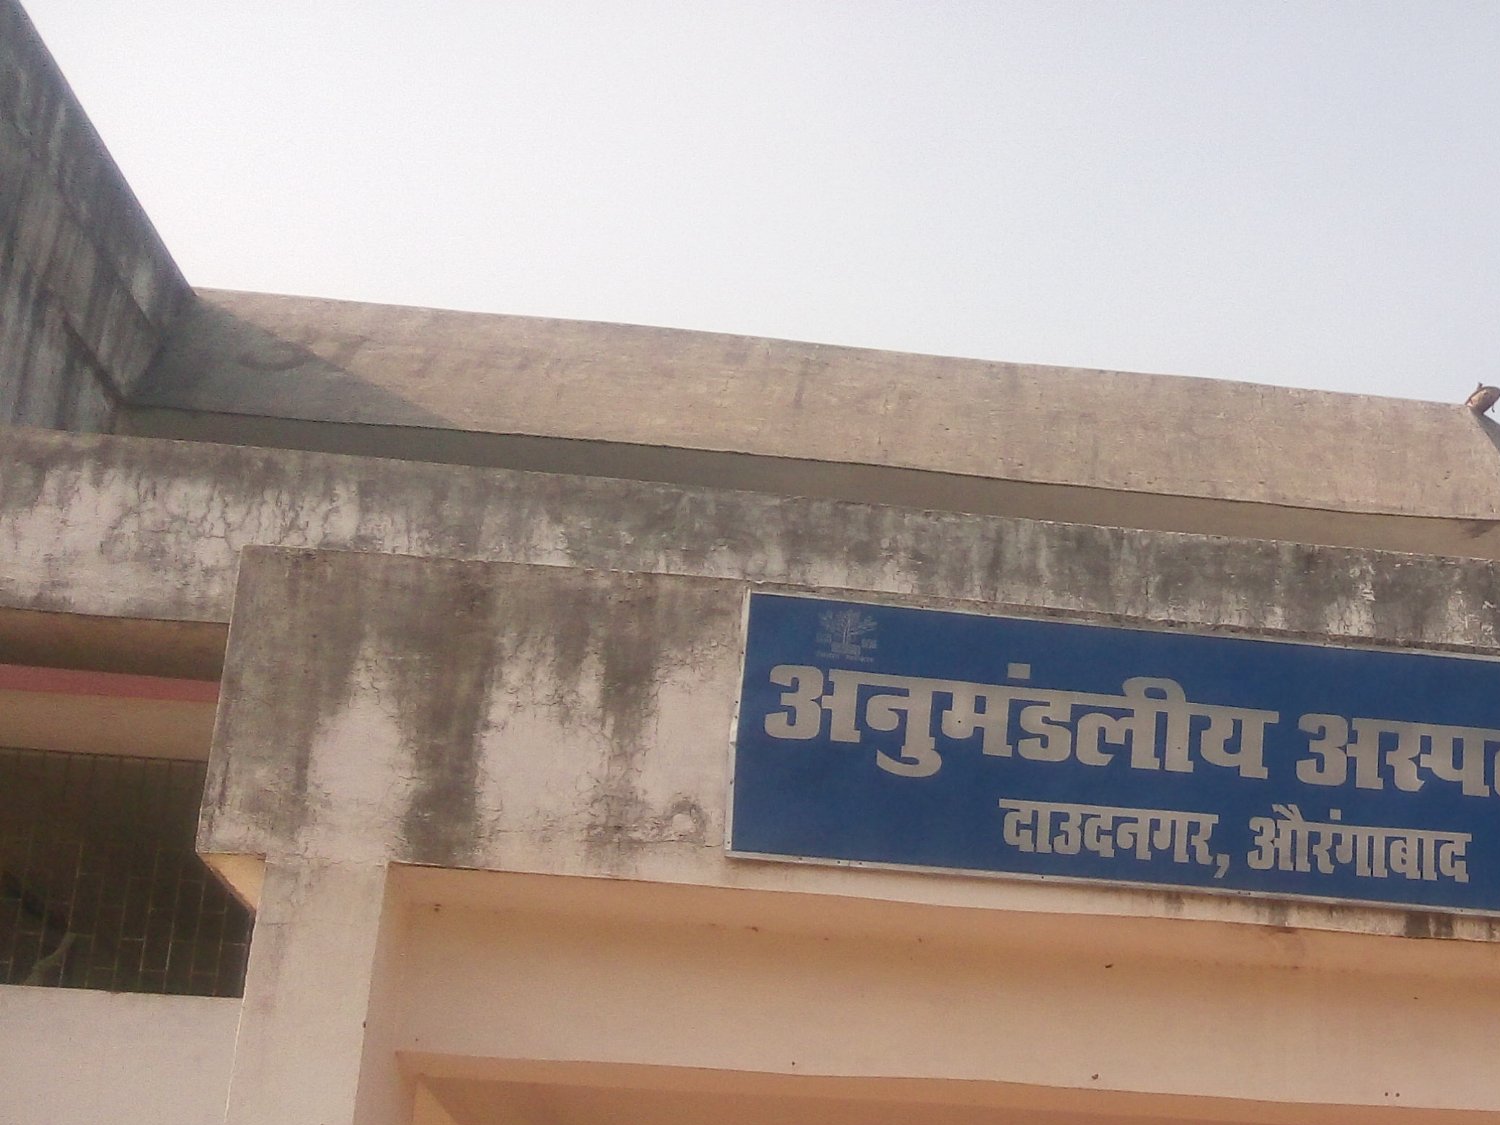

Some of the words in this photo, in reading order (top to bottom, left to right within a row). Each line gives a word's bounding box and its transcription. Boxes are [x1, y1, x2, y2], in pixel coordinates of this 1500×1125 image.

[763, 662, 1280, 779] अनुमंडलीय
[999, 798, 1231, 879] दाउदनगर,
[1247, 803, 1472, 883] औरंगाबाद
